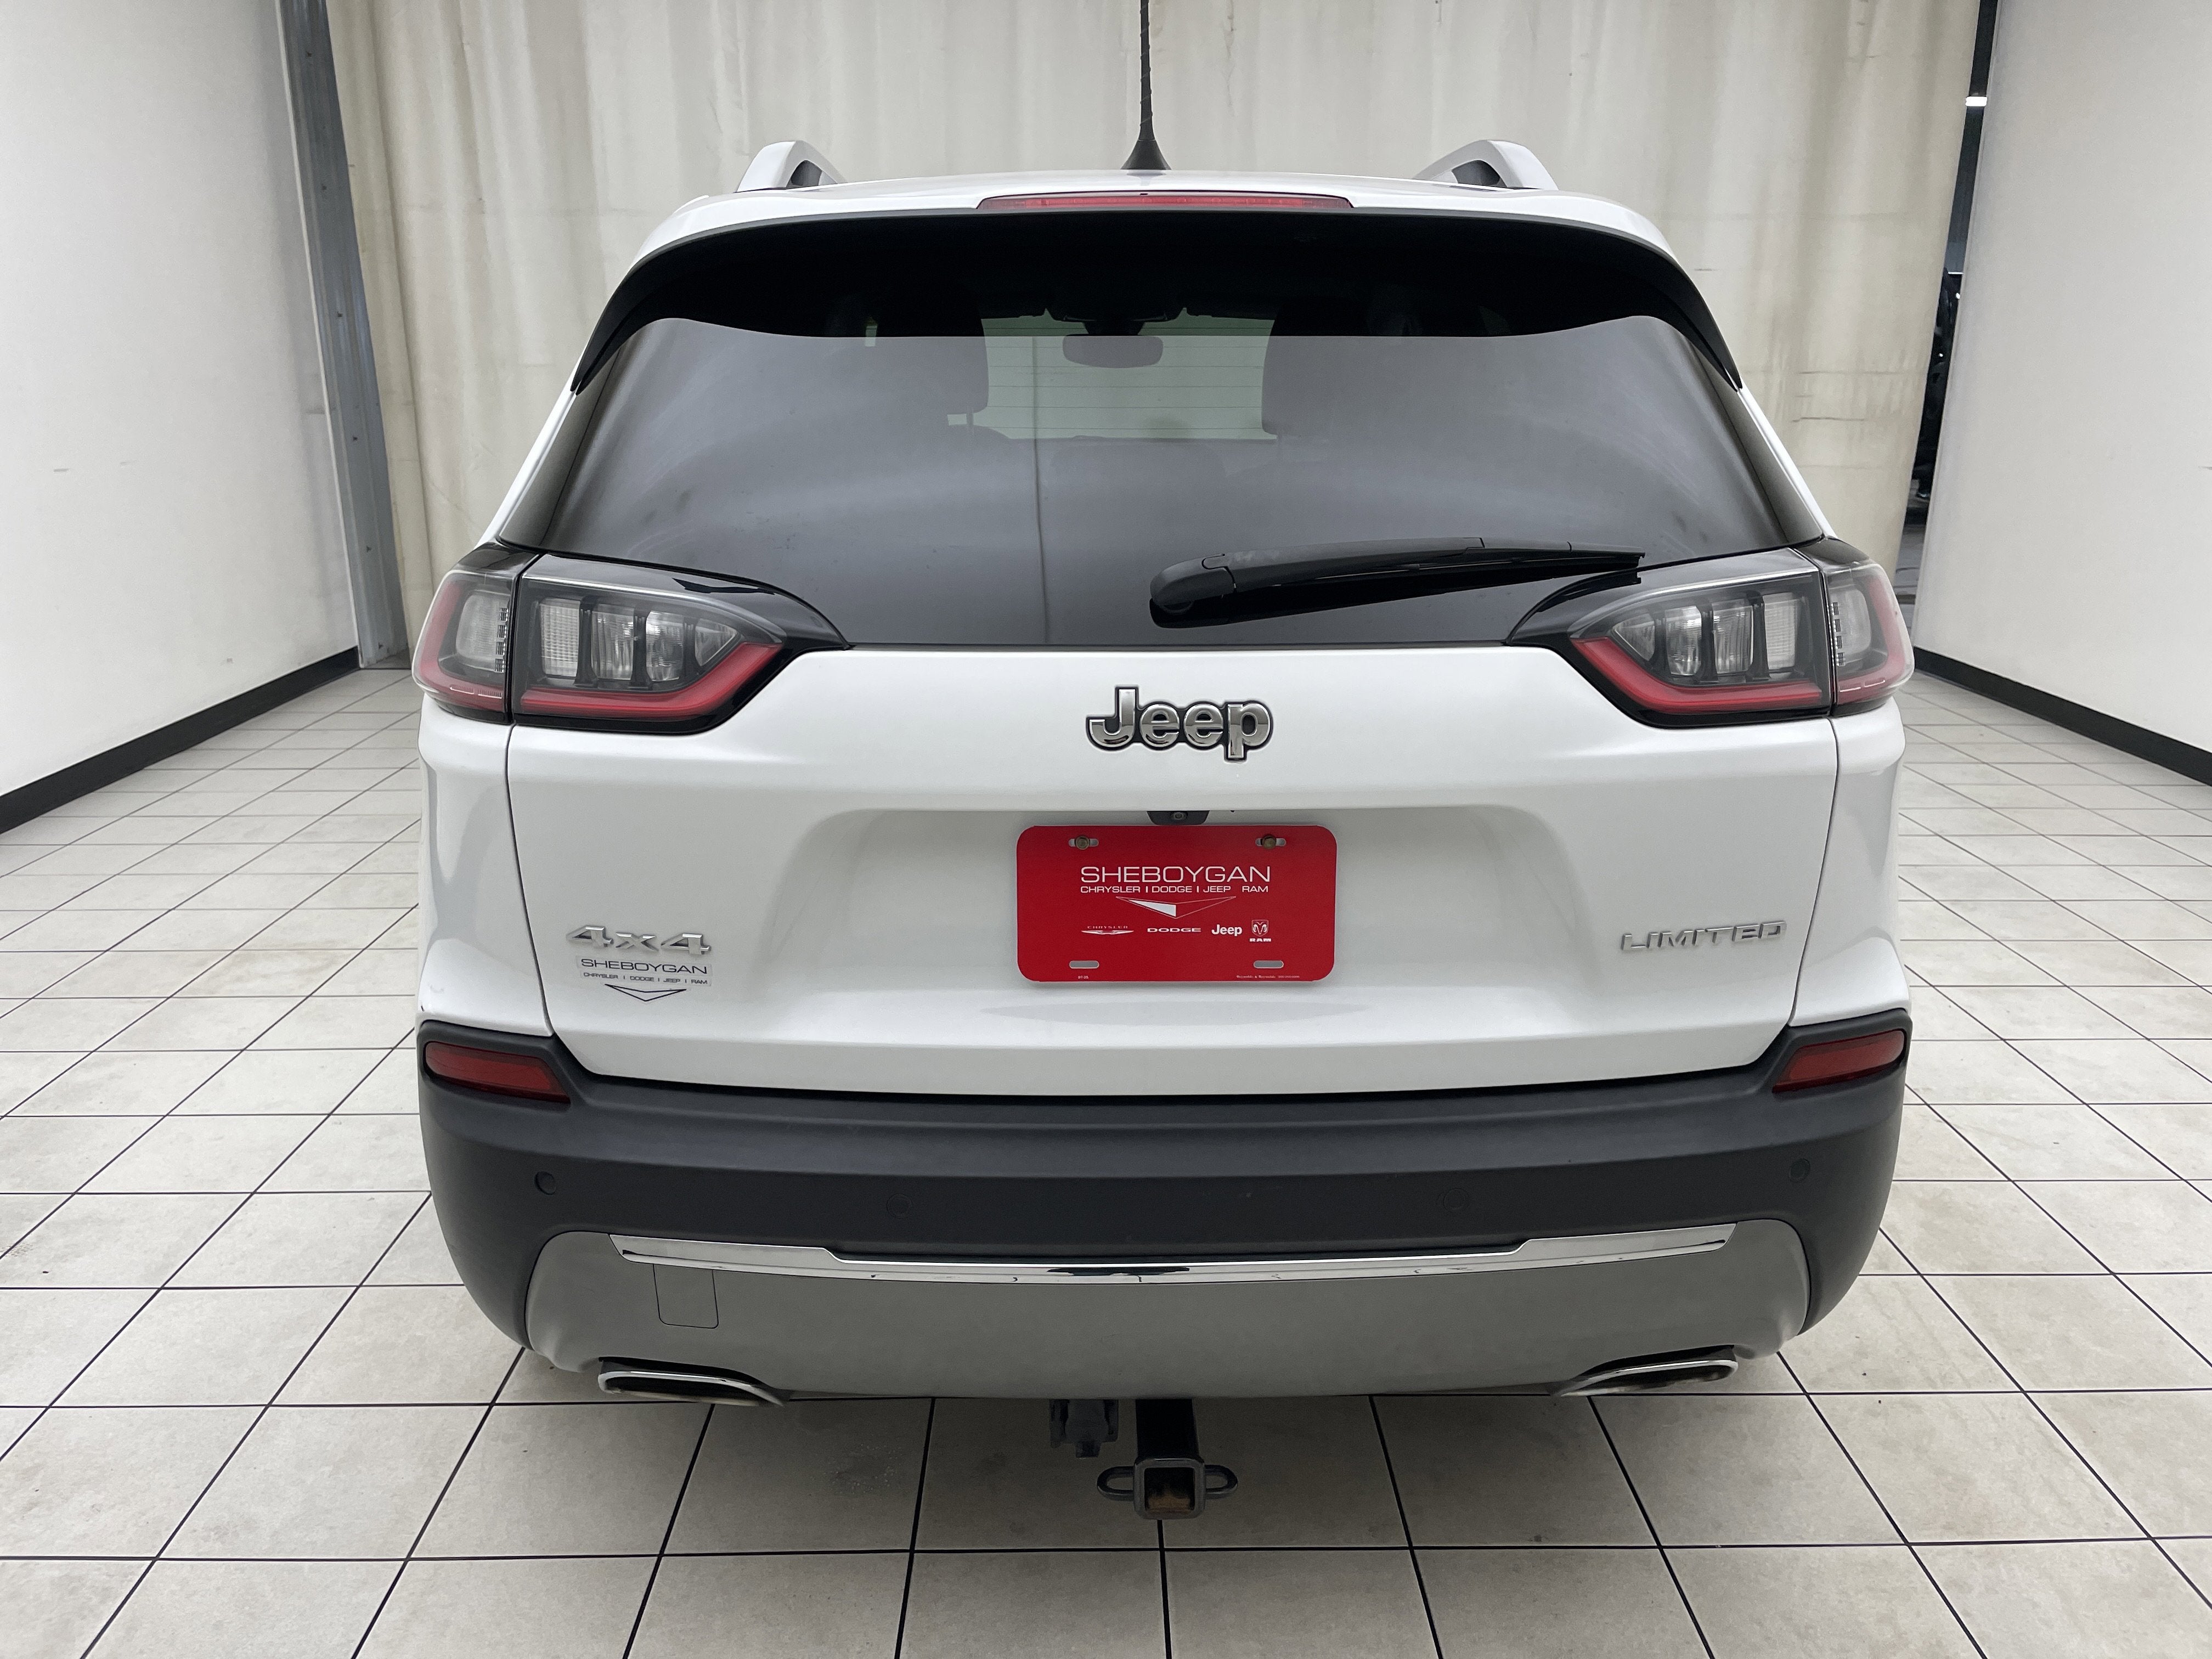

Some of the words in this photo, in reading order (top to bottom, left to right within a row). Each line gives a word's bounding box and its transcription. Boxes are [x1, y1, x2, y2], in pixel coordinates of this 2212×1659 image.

[1086, 686, 1273, 762] Jeep
[1081, 866, 1271, 883] SHEBOYGAN
[1080, 885, 1141, 894] CHRYSLER
[1211, 924, 1243, 936] Jeep
[1621, 920, 1787, 951] LIMITED
[580, 958, 708, 975] SHEBOYGAN
